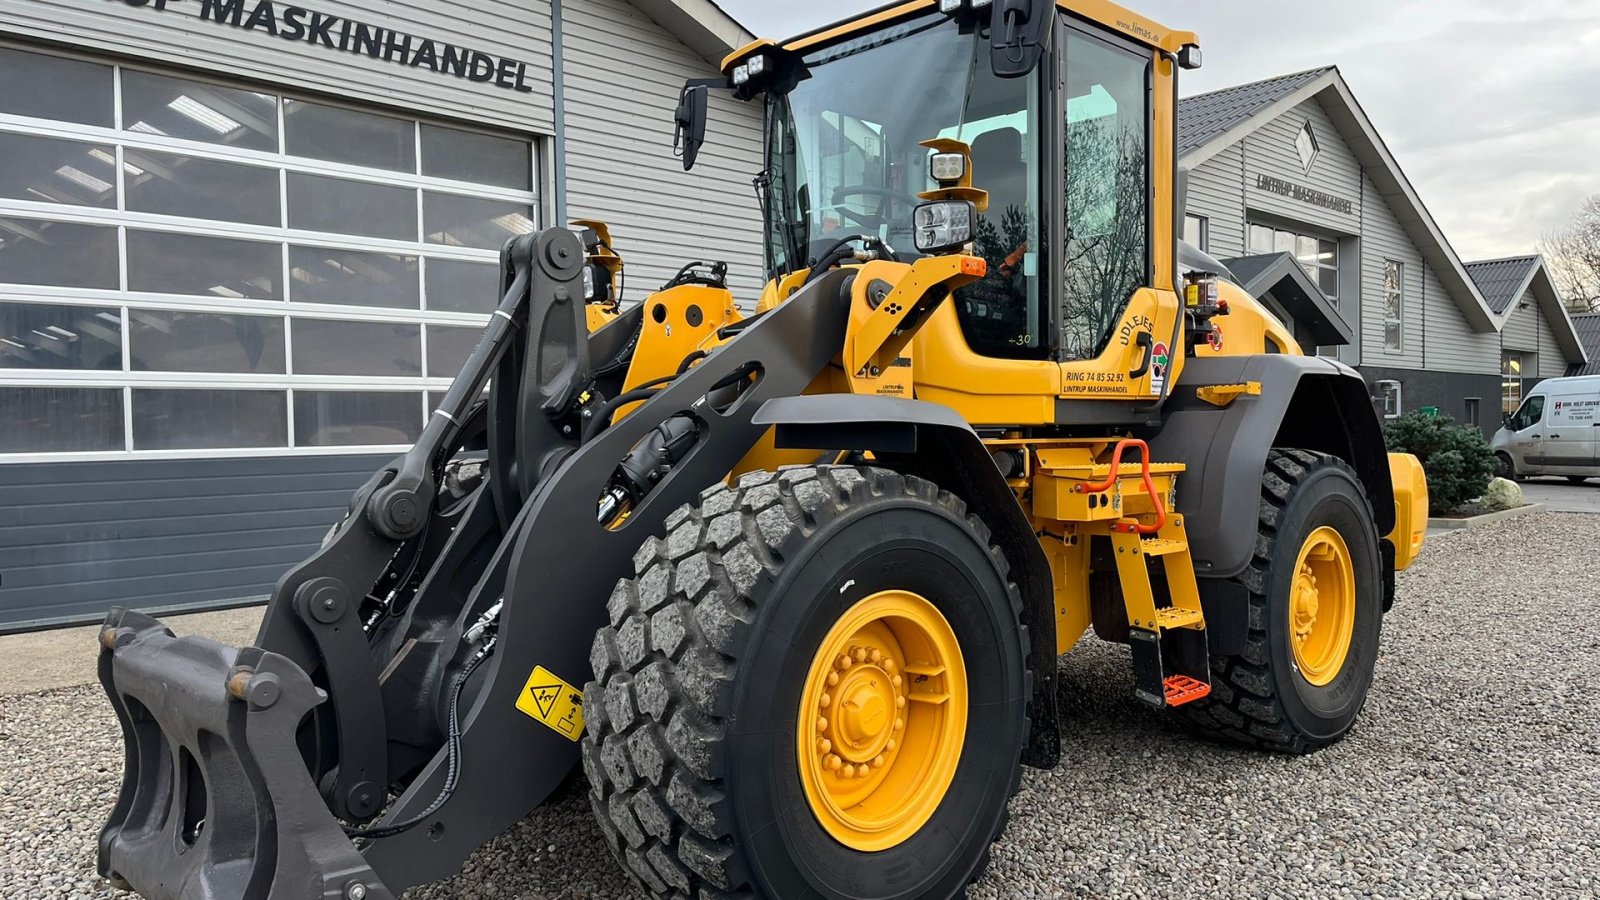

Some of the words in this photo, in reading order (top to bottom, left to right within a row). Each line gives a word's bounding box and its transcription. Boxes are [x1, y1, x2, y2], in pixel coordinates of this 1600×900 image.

[199, 0, 533, 93] MASKINHANDEL
[1256, 173, 1291, 196] LINTRUP
[1293, 184, 1353, 215] MASKINHANDEL
[1120, 315, 1154, 346] UDLEJES
[1063, 385, 1087, 393] LINTRUP
[1066, 372, 1085, 381] RING
[1086, 372, 1095, 381] 74
[1096, 372, 1105, 382] 85
[1106, 373, 1115, 382] 52
[1116, 373, 1124, 382] 92
